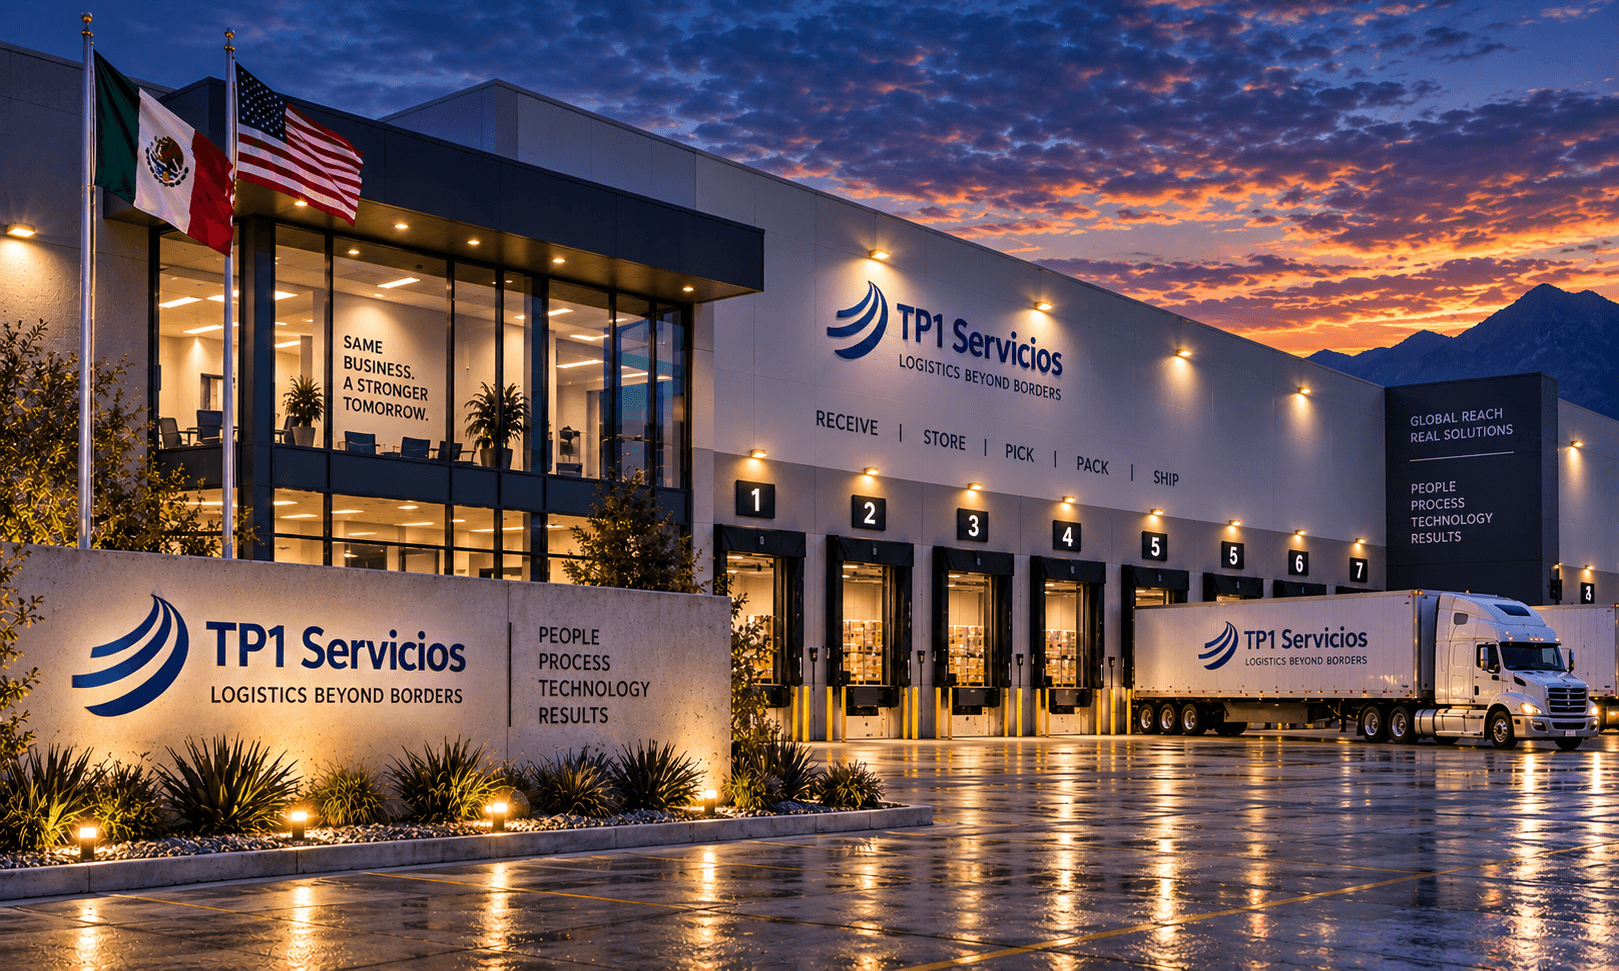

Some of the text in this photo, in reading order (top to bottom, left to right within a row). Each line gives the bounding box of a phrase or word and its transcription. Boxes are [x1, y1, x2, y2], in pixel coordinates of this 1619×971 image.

[343, 334, 383, 355] SAME
[896, 304, 1063, 377] TP1 Servicios
[344, 355, 415, 380] BUSINESS.
[899, 353, 1062, 401] LOGISTICS BEYOND BORDERS
[343, 376, 428, 401] A STRONGER
[343, 396, 429, 421] TOMORROW.
[1410, 407, 1503, 427] GLOBAL REACH
[1410, 423, 1514, 443] REAL SOLUTIONS
[816, 409, 1179, 487] RECEIVE STORE PICK PACK SHIP
[1411, 480, 1456, 494] PEOPLE
[751, 487, 760, 512] 1
[1411, 497, 1465, 511] PROCESS
[863, 501, 876, 525] 2
[1410, 512, 1493, 528] TECHNOLOGY
[967, 514, 980, 537] 3
[1062, 526, 1074, 547] 4
[1151, 536, 1160, 557] 5
[1411, 530, 1462, 544] RESULTS
[1229, 546, 1238, 565] 5
[1295, 554, 1304, 573] 6
[1355, 561, 1364, 579] 7
[539, 626, 600, 646] PEOPLE
[1243, 625, 1368, 650] TP1 Servicios
[205, 621, 467, 673] TP1 Servicios
[539, 652, 611, 672] PROCESS
[1245, 655, 1368, 667] LOGISTICS BEYOND BORDERS
[211, 685, 463, 704] LOGISTICS BEYOND BORDERS
[538, 679, 651, 698] TECHNOLOGY
[539, 706, 609, 725] RESULTS
